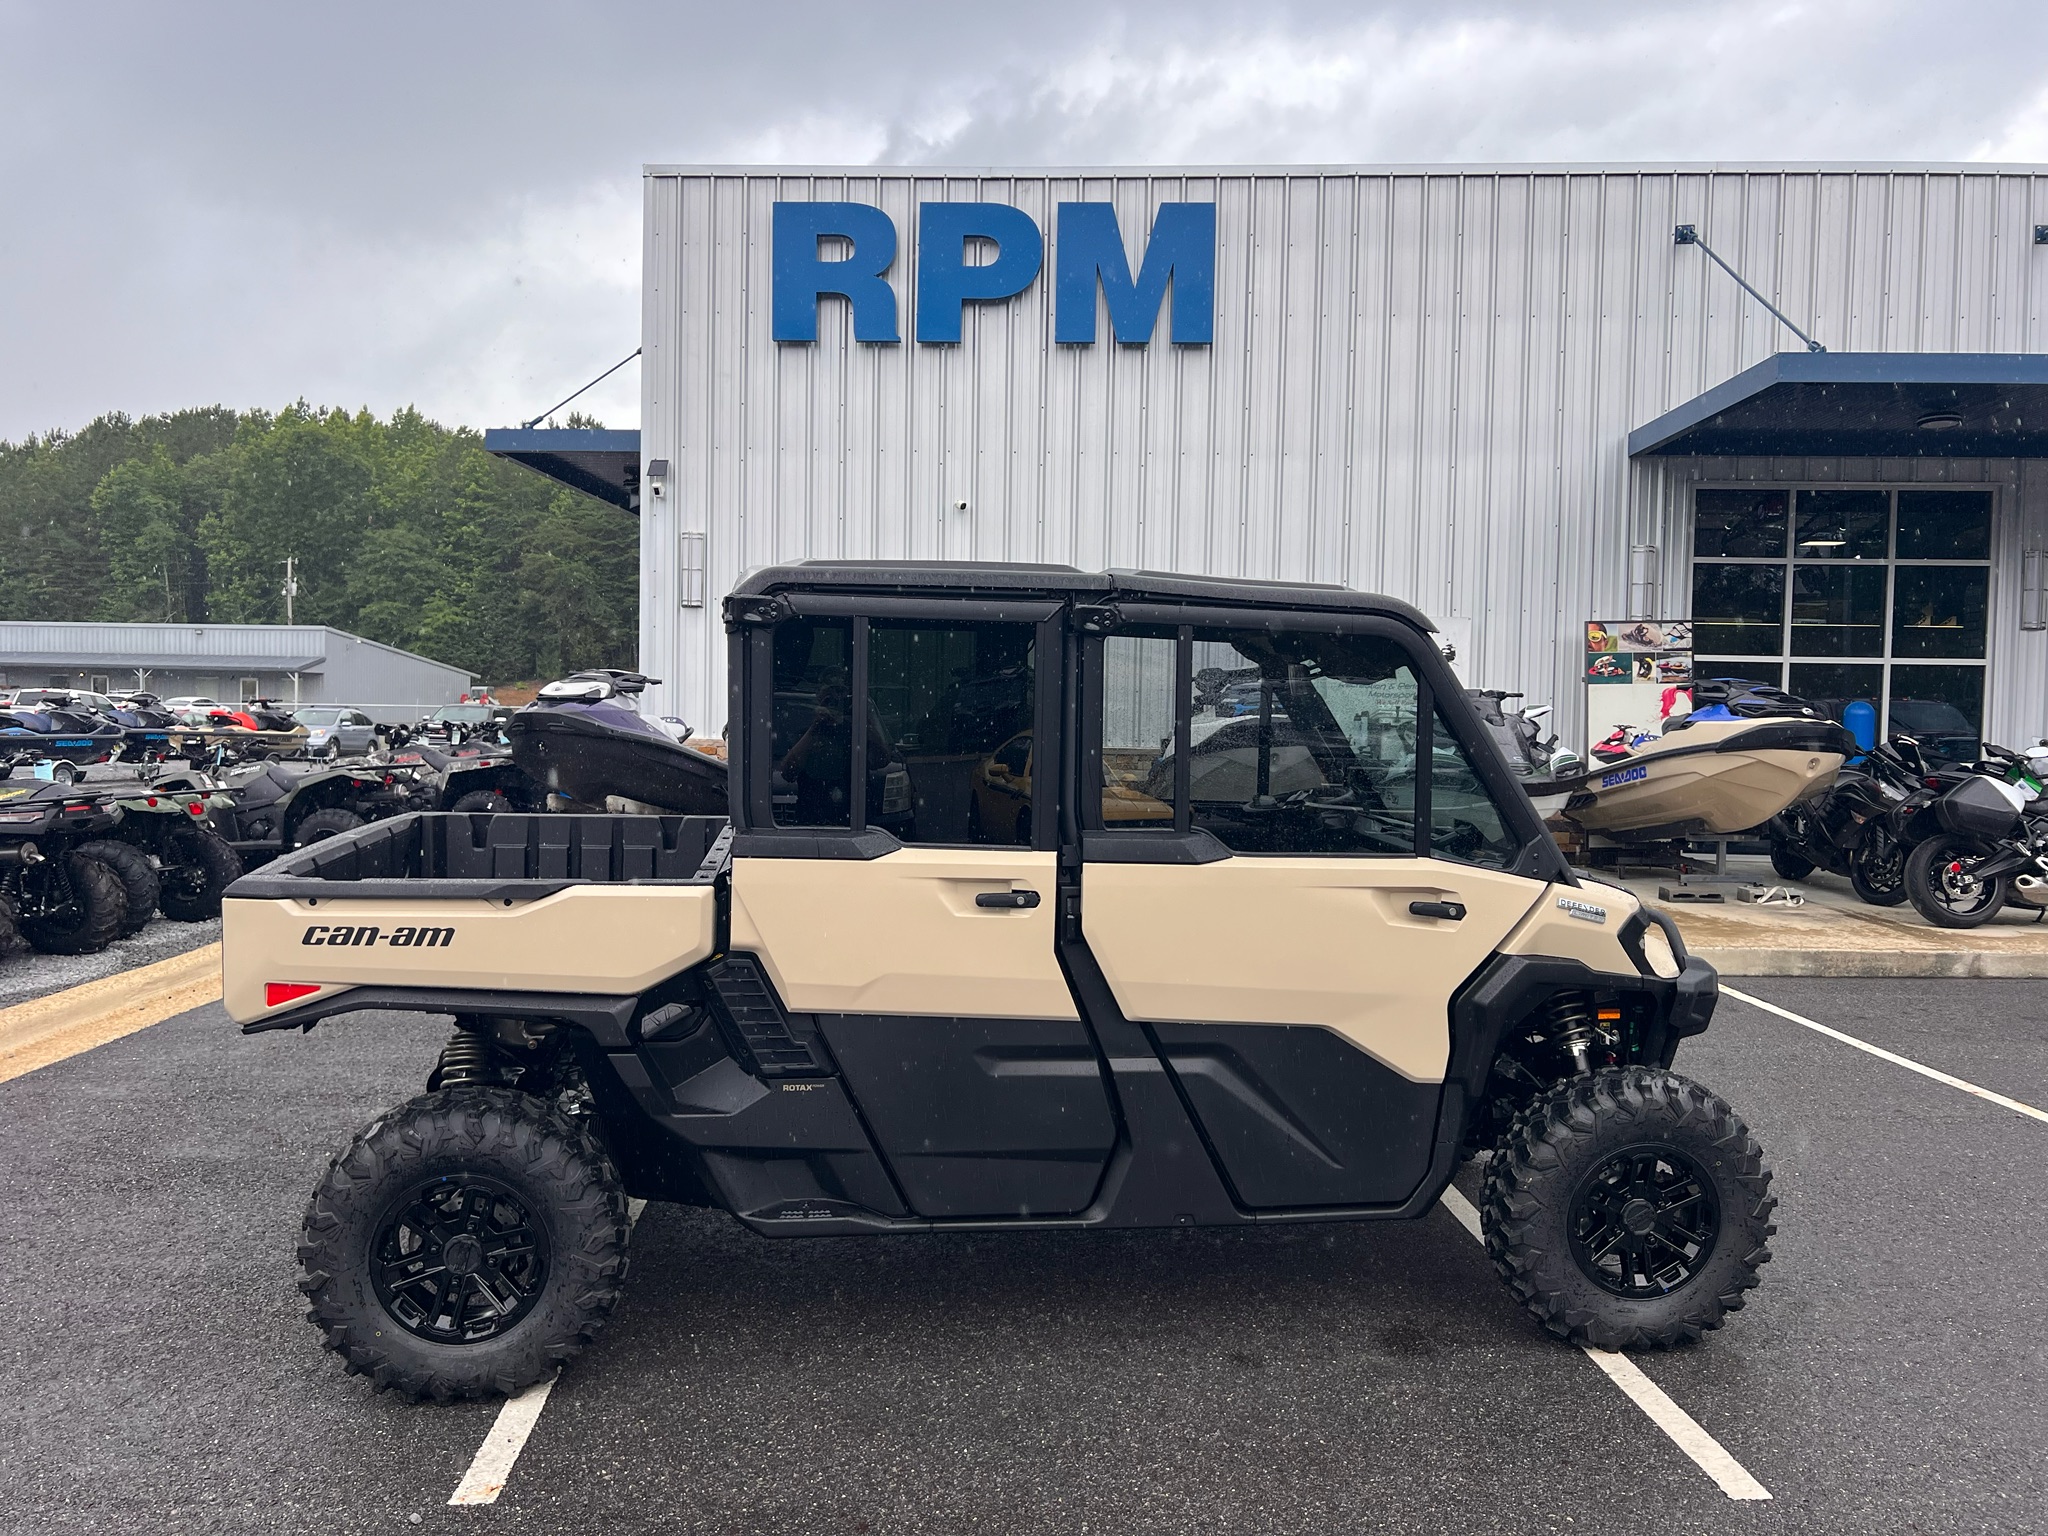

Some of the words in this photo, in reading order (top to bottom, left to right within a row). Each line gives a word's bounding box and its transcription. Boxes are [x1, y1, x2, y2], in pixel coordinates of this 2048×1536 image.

[772, 201, 1216, 344] RPM
[1560, 899, 1606, 915] DEFENDER
[302, 926, 456, 946] can-am
